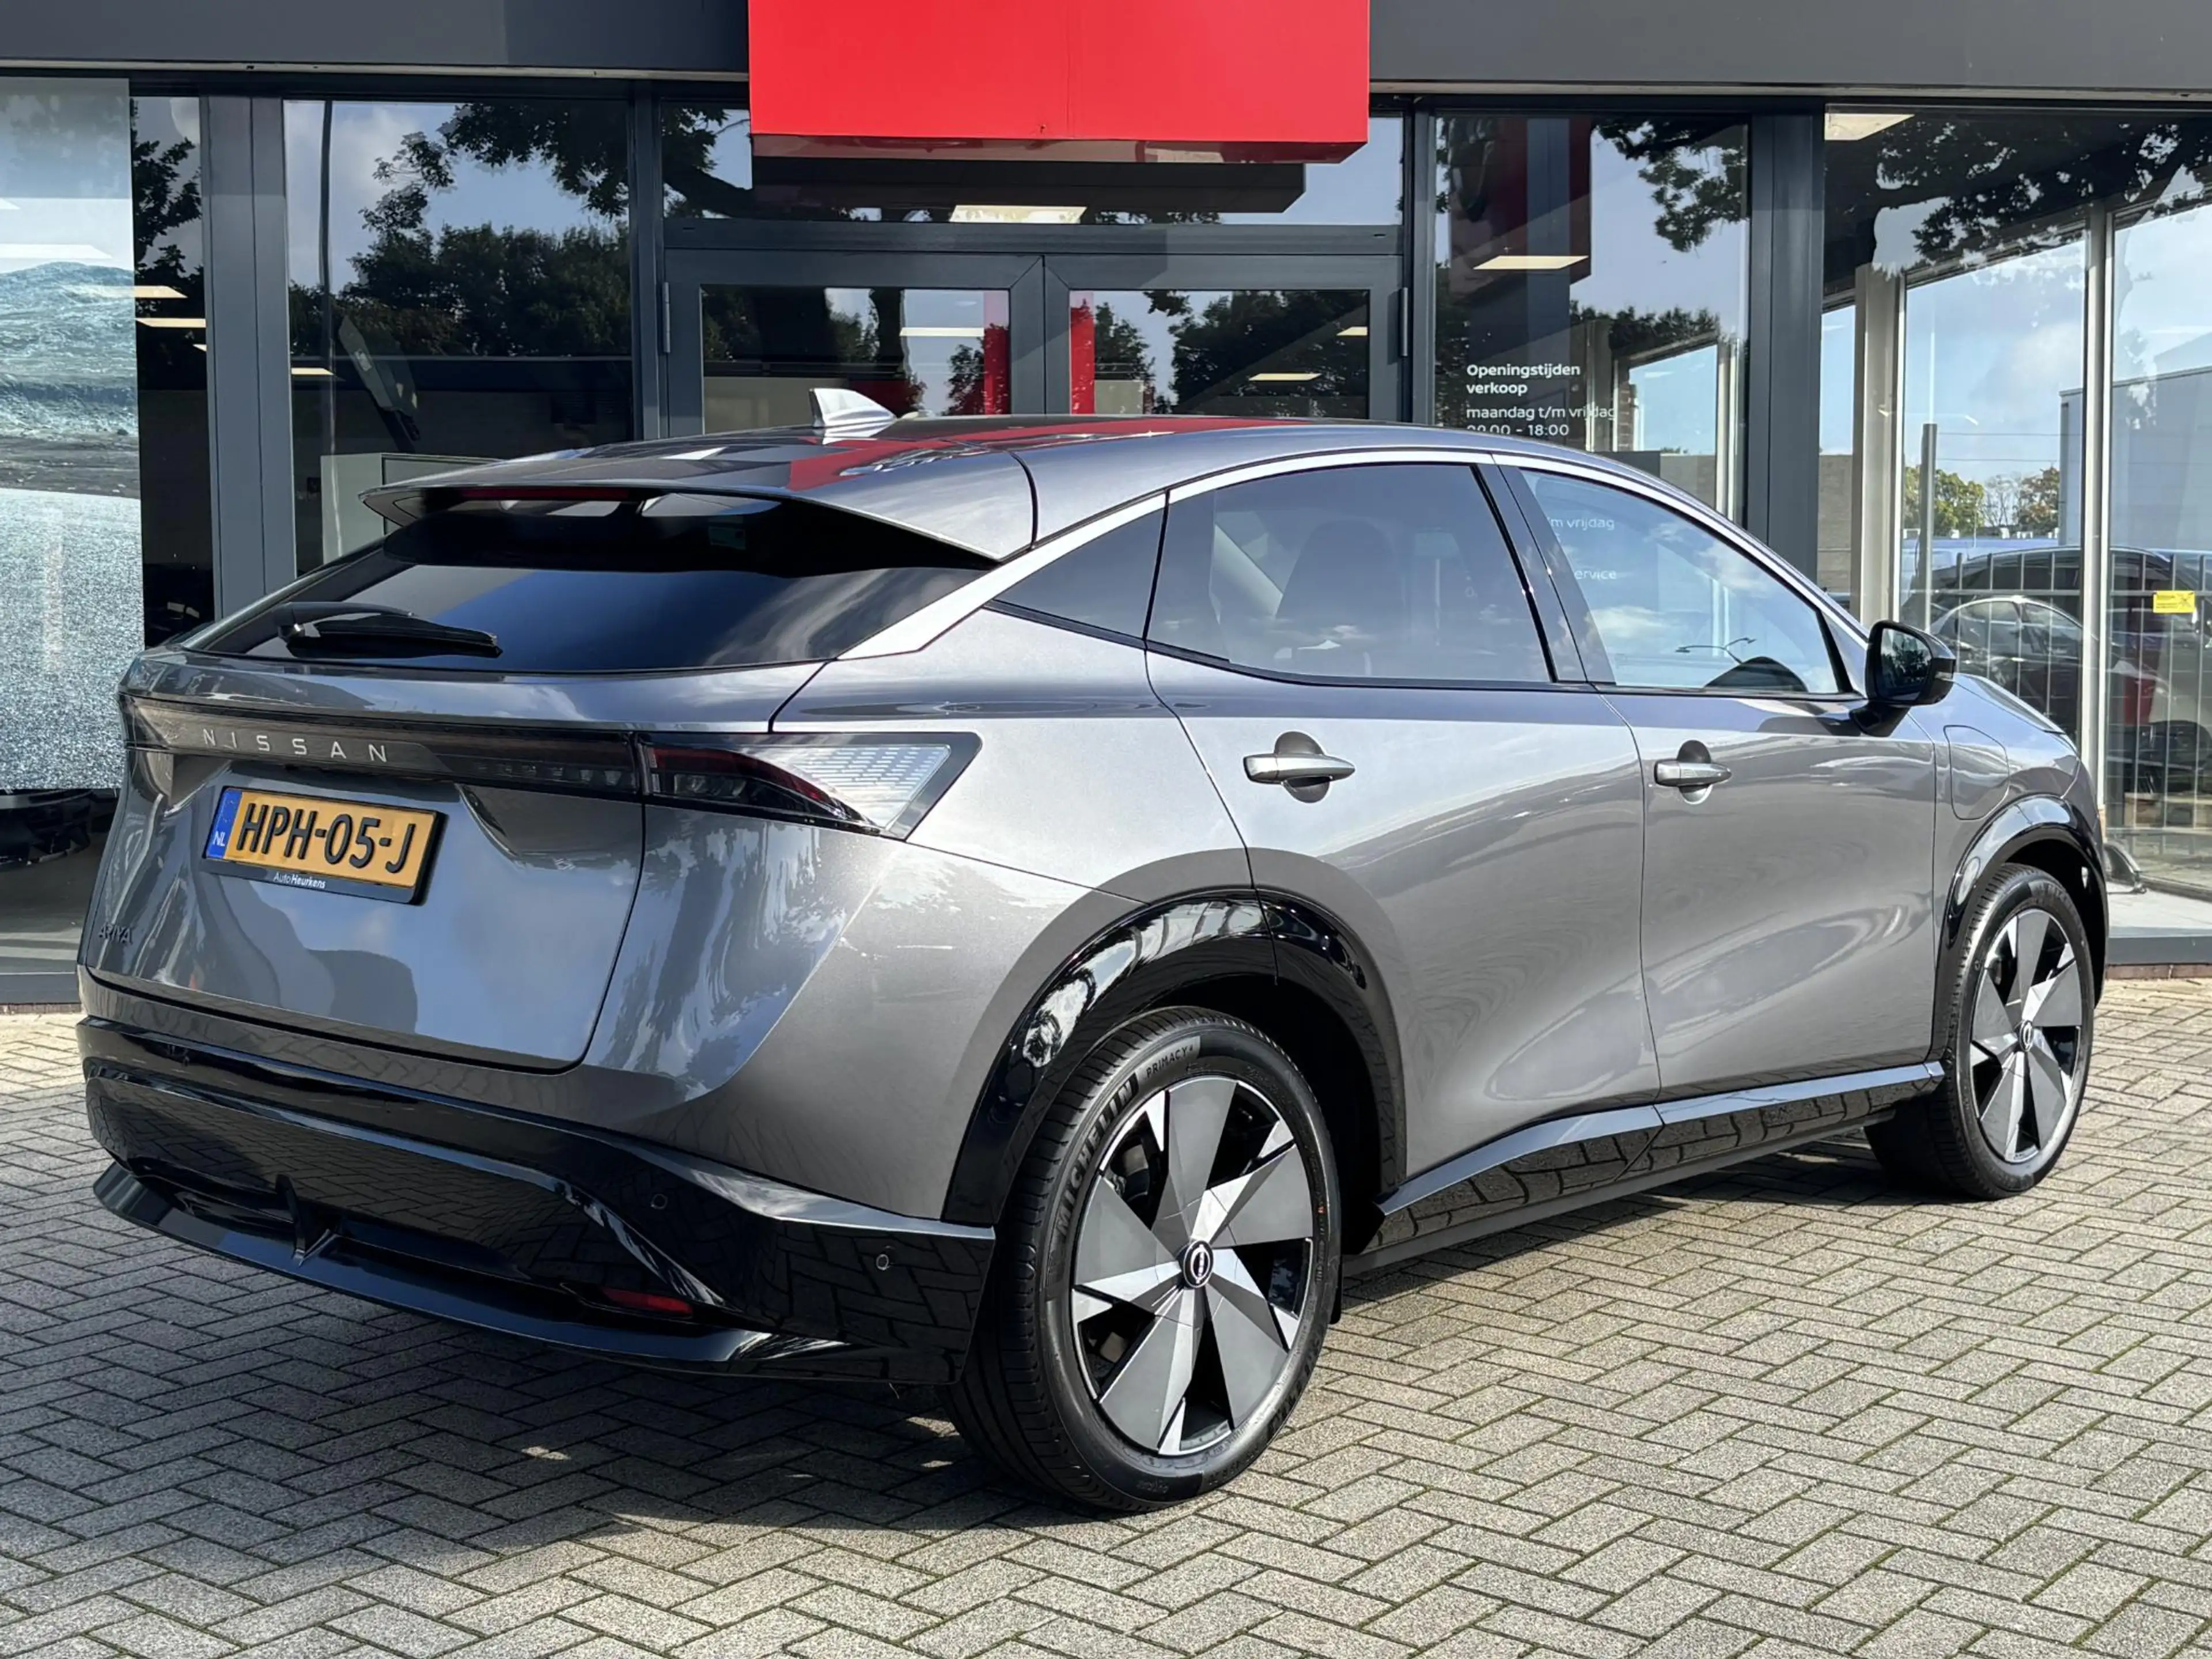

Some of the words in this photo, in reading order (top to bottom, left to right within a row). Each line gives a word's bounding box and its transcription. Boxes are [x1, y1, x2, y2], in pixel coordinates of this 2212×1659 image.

[1467, 363, 1581, 378] Openingstijden
[1467, 382, 1528, 396] verkoop
[1467, 406, 1535, 421] maandag
[1538, 406, 1566, 419] t/m
[1528, 424, 1569, 436] 18:00
[1567, 518, 1615, 531] vrijdag
[1574, 570, 1617, 579] ervice
[203, 728, 387, 763] NISSAN
[213, 830, 226, 847] NL
[237, 802, 416, 874] HPH-05-J
[1146, 1046, 1188, 1078] PRIMACY
[1056, 1079, 1132, 1236] MICHELIN
